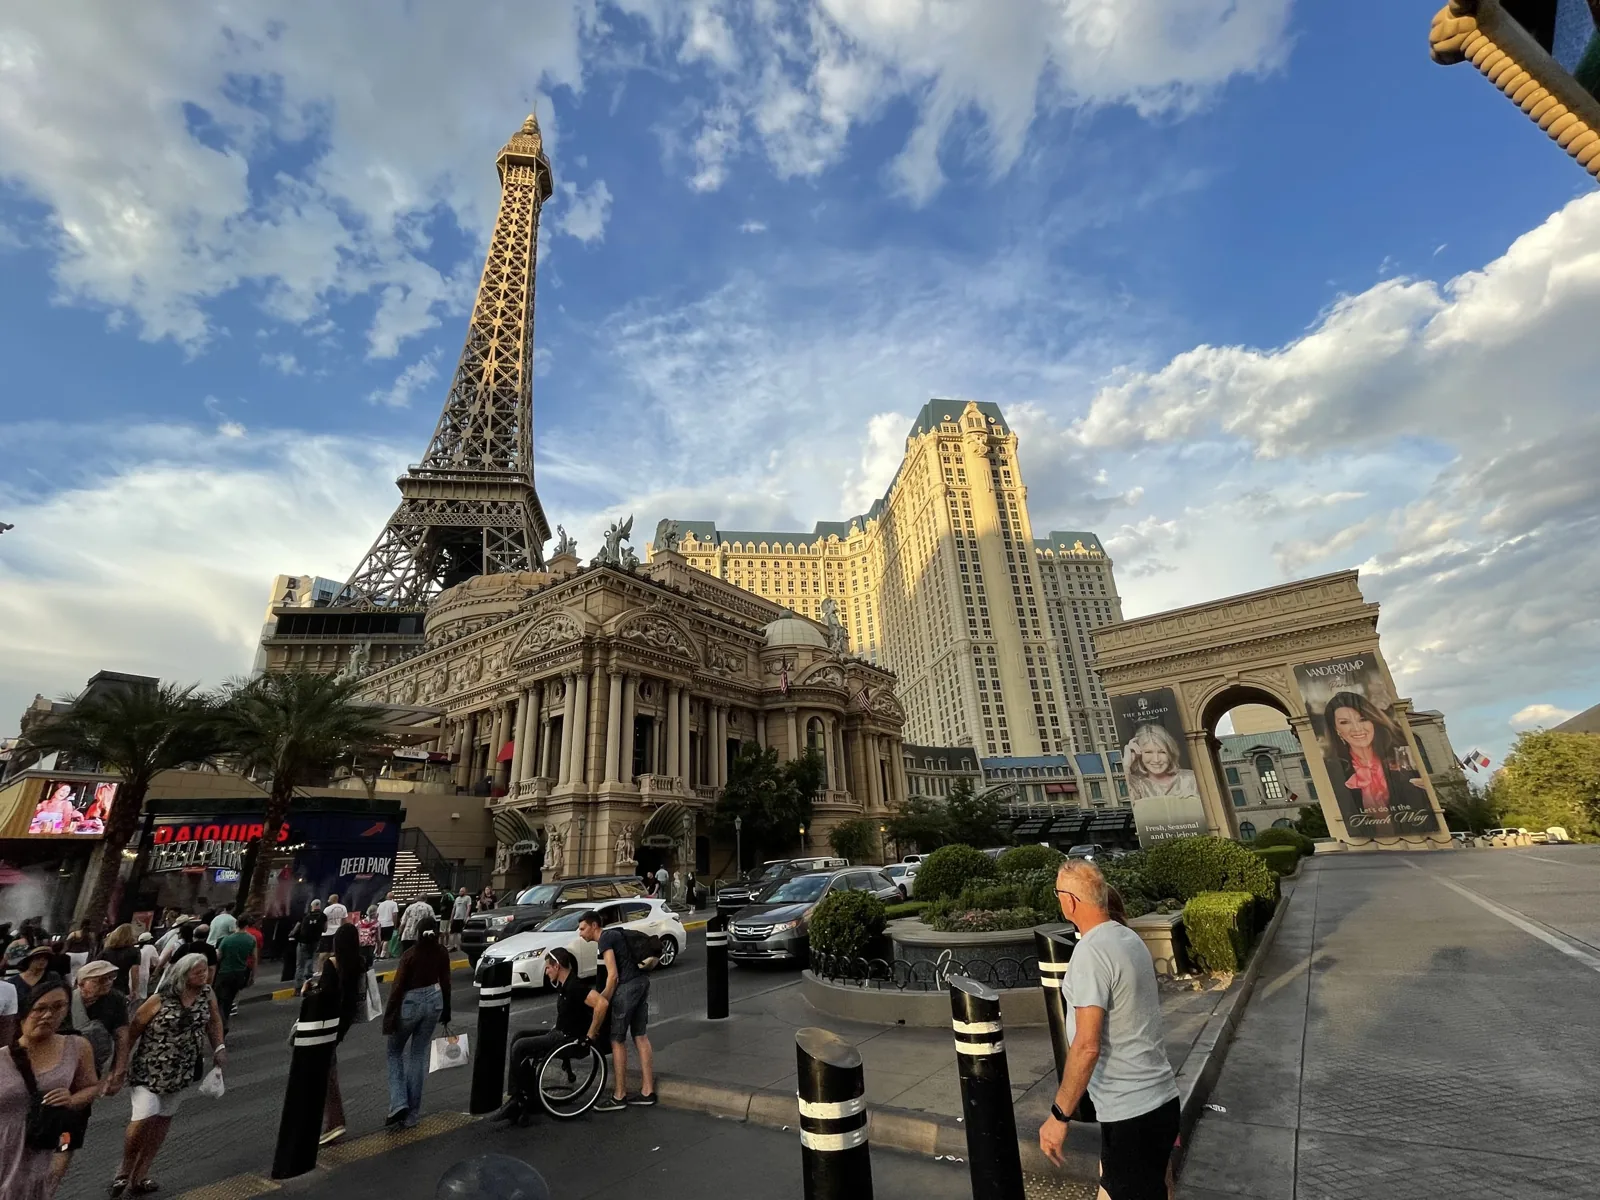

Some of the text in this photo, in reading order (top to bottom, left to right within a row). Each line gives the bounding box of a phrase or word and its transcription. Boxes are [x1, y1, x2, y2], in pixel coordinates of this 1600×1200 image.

[361, 603, 425, 613] EIFFEL TOWER
[1305, 660, 1364, 677] VANDERPUMP
[1137, 707, 1169, 717] BEDFORD
[1360, 803, 1411, 814] Let's do it the
[1349, 808, 1429, 828] French Way
[154, 822, 291, 844] DAIQUIRS
[1167, 821, 1200, 831] Seasonal
[1150, 832, 1165, 840] and
[150, 839, 248, 871] BEER PARK
[339, 857, 391, 877] BEER PARK
